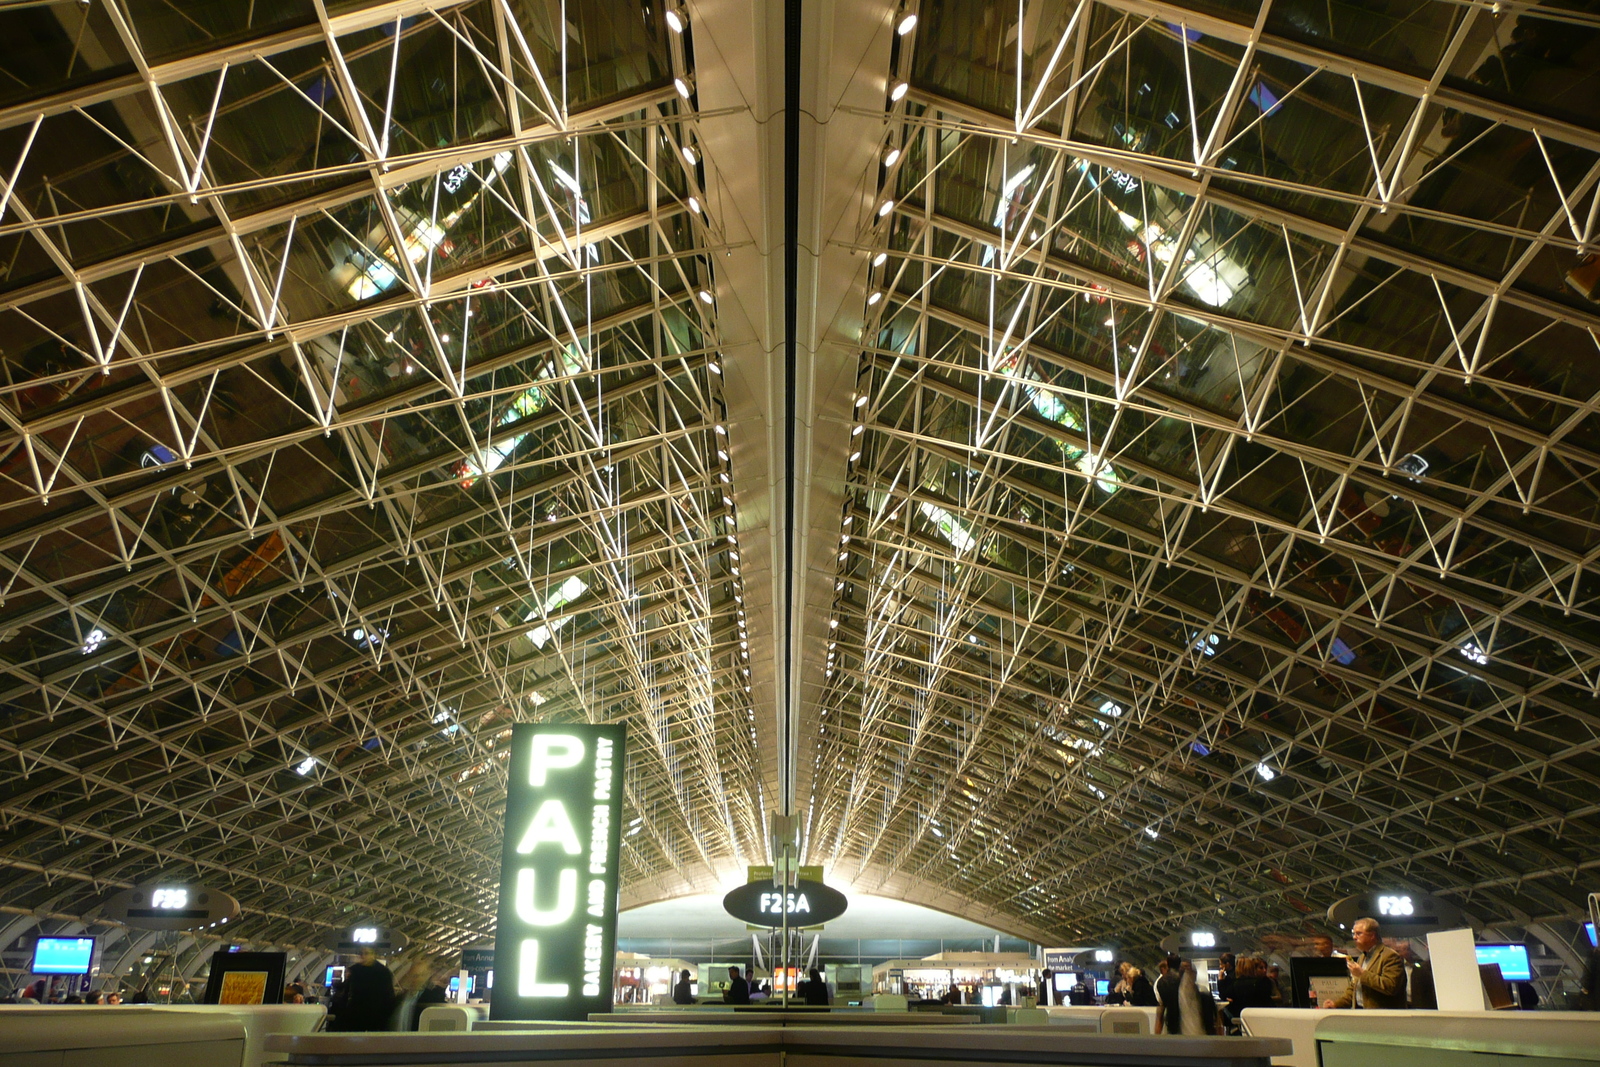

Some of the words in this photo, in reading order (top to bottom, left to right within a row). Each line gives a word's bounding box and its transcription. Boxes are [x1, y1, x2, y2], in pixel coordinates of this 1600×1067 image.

[594, 736, 613, 799] PASTRY
[515, 733, 586, 997] PAUL
[590, 805, 609, 874] FRENCH
[587, 879, 605, 917] AND
[760, 893, 810, 913] F25A
[1379, 896, 1414, 916] F26
[583, 924, 602, 996] BAKERY
